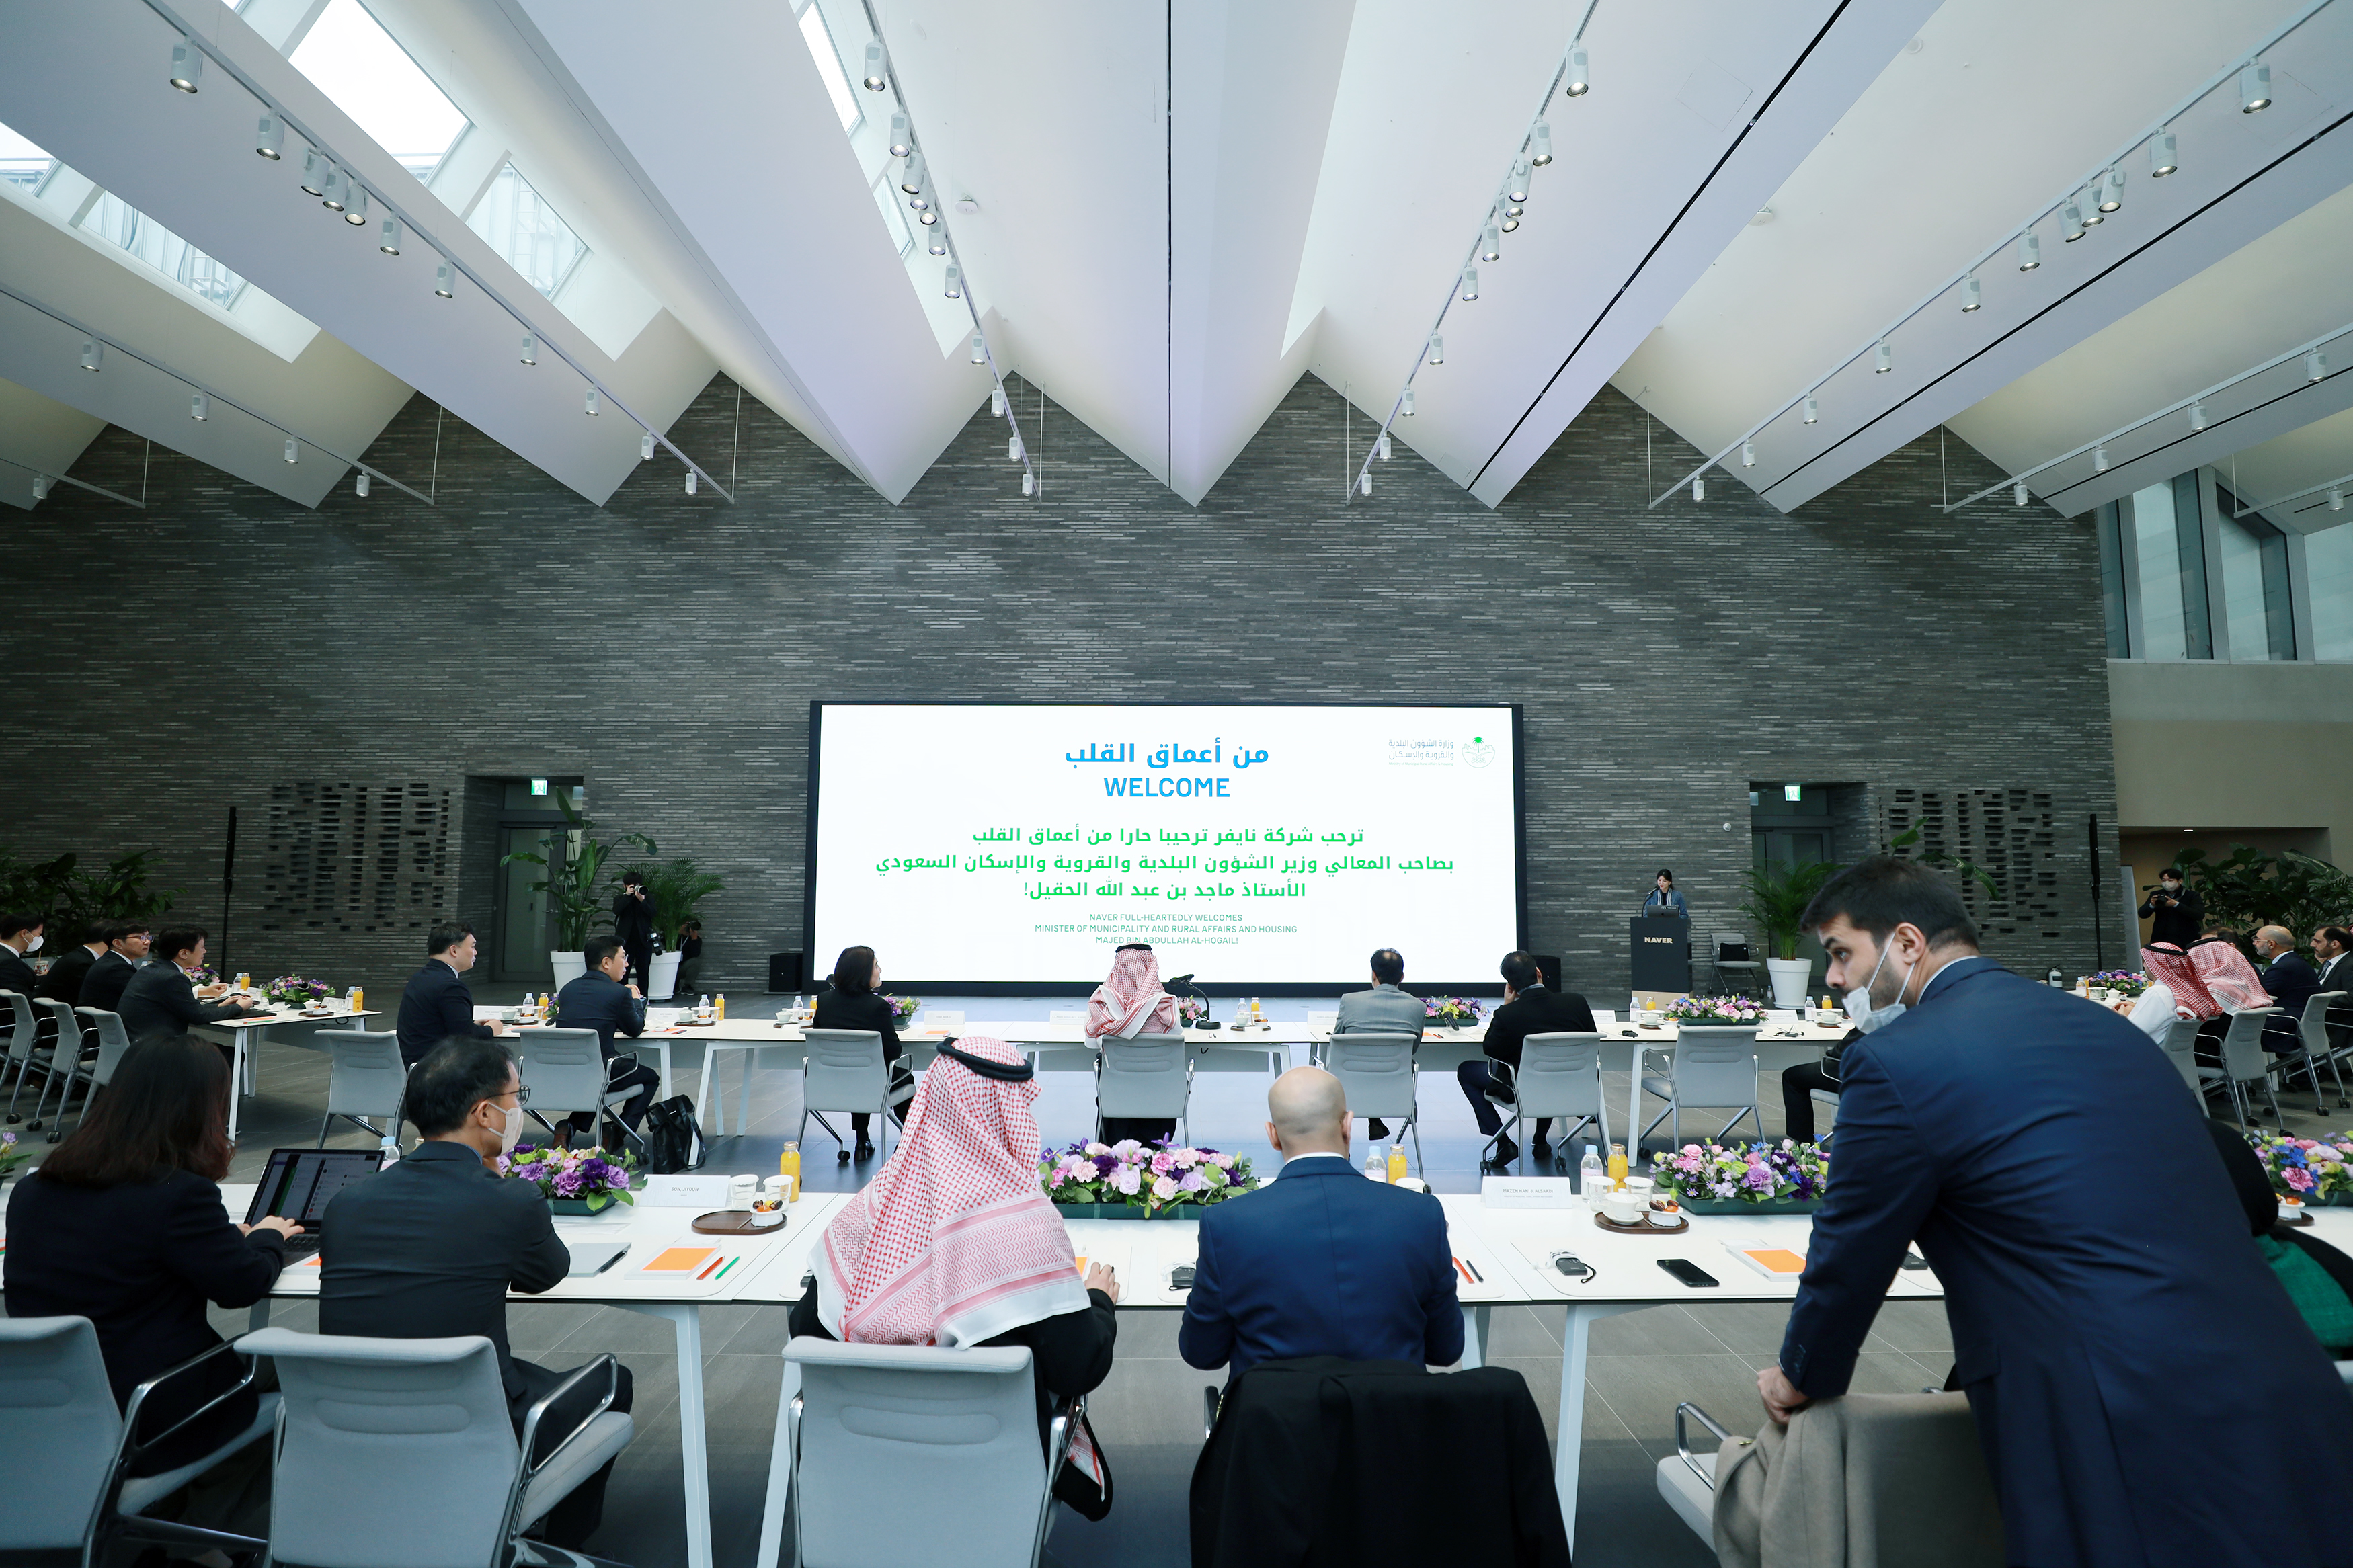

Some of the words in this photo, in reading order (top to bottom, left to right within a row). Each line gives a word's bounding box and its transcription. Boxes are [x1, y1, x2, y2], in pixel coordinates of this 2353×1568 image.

[1147, 737, 1220, 768] أعماق
[1388, 739, 1408, 749] البلدية
[1439, 739, 1453, 749] وزارة
[1066, 743, 1135, 768] القلب
[1233, 745, 1269, 768] من
[1425, 751, 1453, 760] والقروية
[1103, 778, 1230, 797] WELCOME
[973, 828, 1021, 845] القلب
[1029, 823, 1079, 845] أعماق
[1088, 829, 1112, 845] من
[1121, 828, 1151, 845] حارا
[1160, 828, 1208, 846] ترحيبا
[1214, 829, 1256, 846] نايفر
[1264, 827, 1312, 846] شركة
[1321, 829, 1364, 846] ترحب
[876, 855, 956, 876] السعودي
[965, 854, 1046, 874] والإسكان
[1054, 855, 1131, 873] والقروية
[1139, 855, 1196, 873] البلدية
[1205, 854, 1274, 873] الشؤون
[1281, 856, 1318, 873] وزير
[1325, 856, 1390, 877] المعالي
[1398, 856, 1453, 874] بصاحب
[1025, 882, 1088, 900] الحقيل!
[1096, 876, 1123, 896] الله
[1131, 885, 1159, 901] عبد
[1167, 884, 1187, 901] بن
[1195, 883, 1235, 901] ماجد
[1242, 878, 1306, 897] الأستاذ
